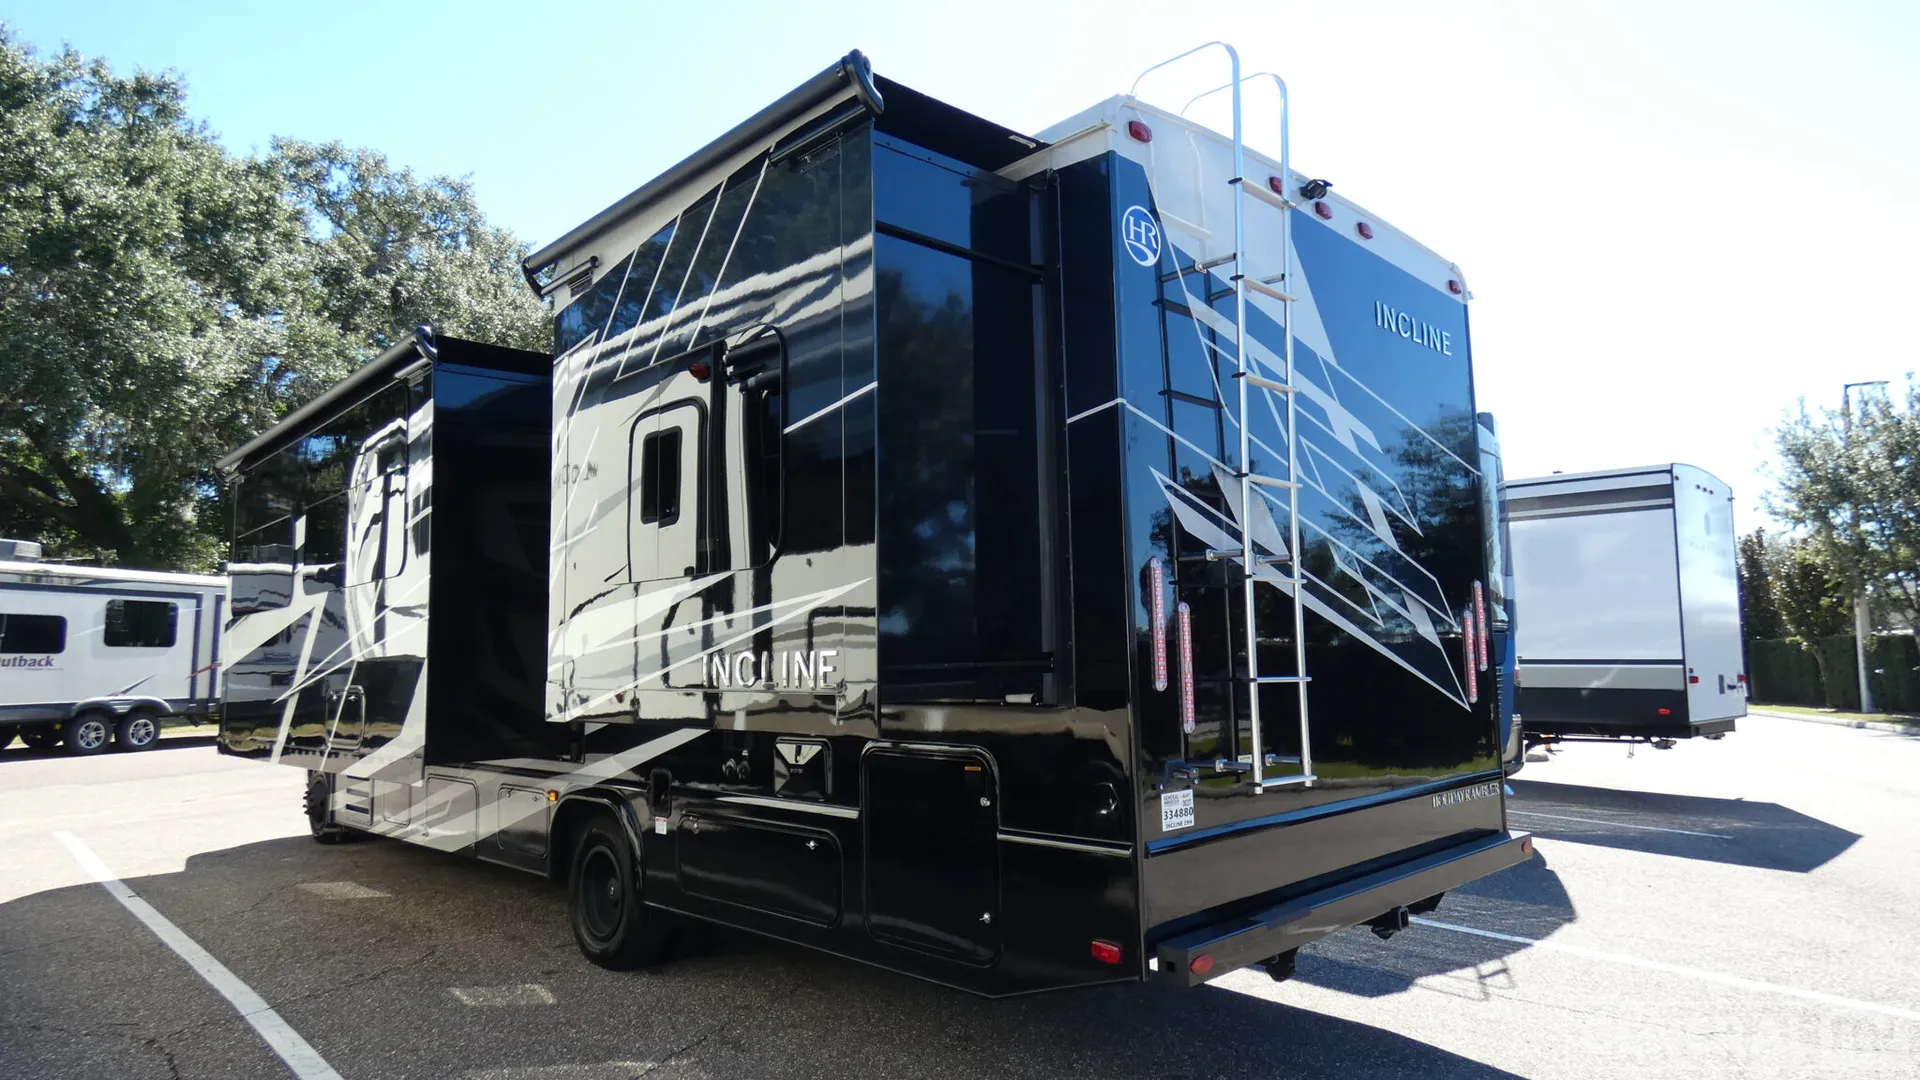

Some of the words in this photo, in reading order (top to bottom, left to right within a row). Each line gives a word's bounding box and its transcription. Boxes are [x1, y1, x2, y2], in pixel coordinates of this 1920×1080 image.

[1128, 215, 1158, 249] HR
[1375, 300, 1452, 356] INCLINE
[0, 655, 55, 667] utback
[702, 650, 839, 690] INCLINE
[1163, 806, 1194, 821] 334880
